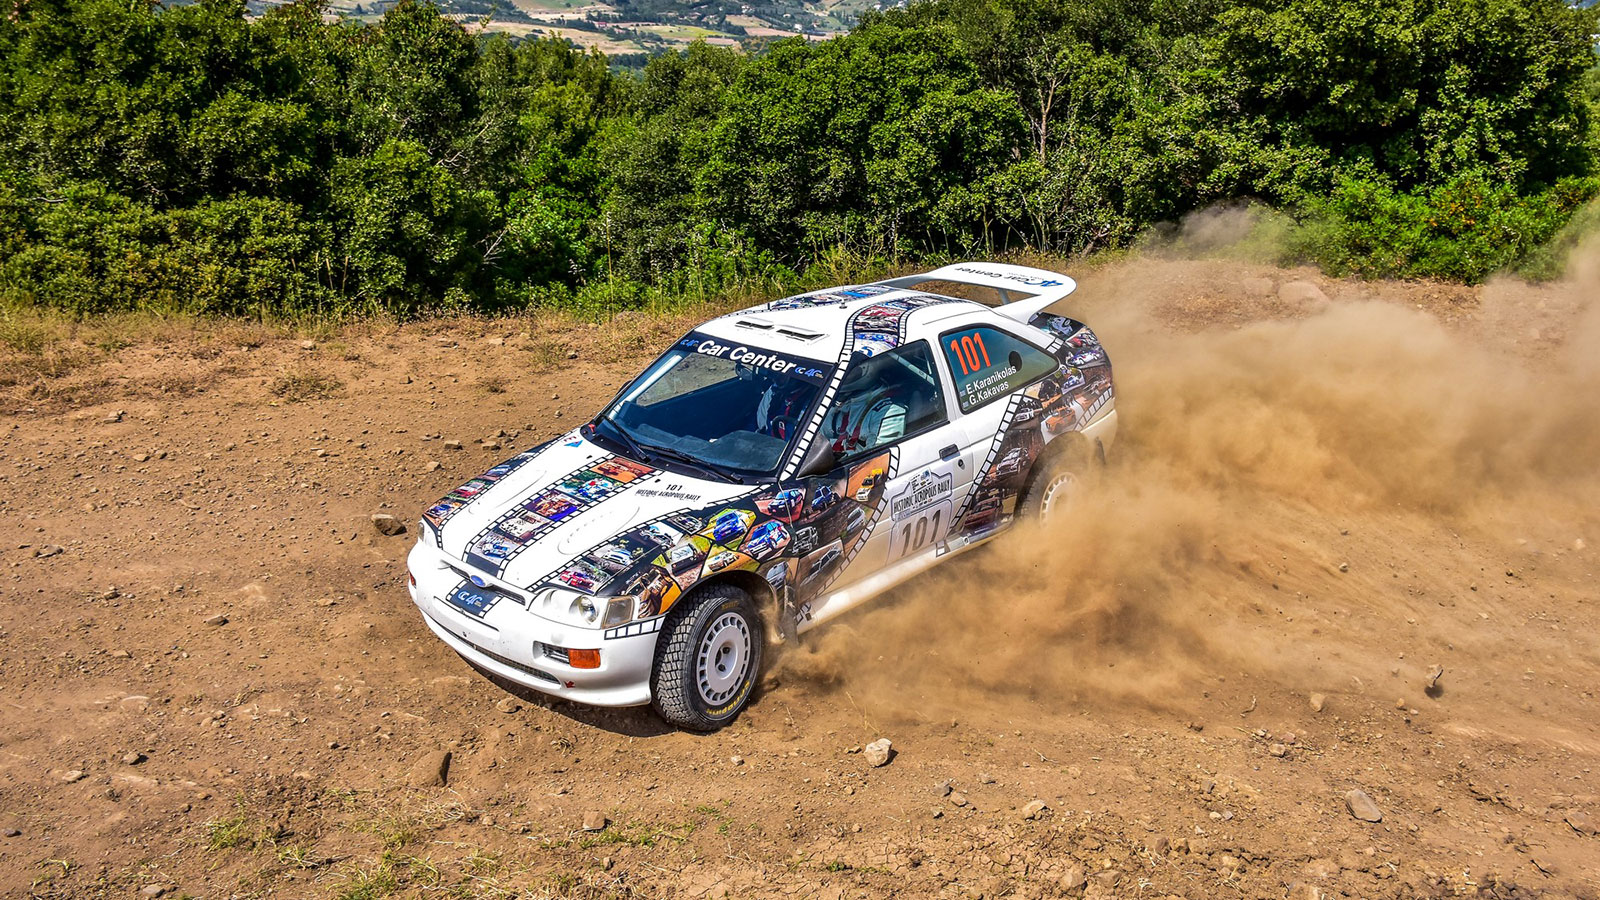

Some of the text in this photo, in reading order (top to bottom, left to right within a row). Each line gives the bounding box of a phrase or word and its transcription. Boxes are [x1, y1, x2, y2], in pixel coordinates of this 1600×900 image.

[955, 267, 1002, 277] Center
[697, 340, 731, 357] Car
[729, 346, 796, 374] Center
[950, 332, 992, 376] 101
[965, 365, 1017, 395] E.Karanikolas
[969, 381, 1009, 406] G.Kakavas
[635, 489, 659, 497] HISTORIC
[658, 491, 685, 499] ACROPOLIS
[894, 496, 914, 513] HISTORIC
[914, 484, 937, 502] ACROPOLIS
[937, 479, 950, 493] RALLY
[902, 509, 941, 556] 101
